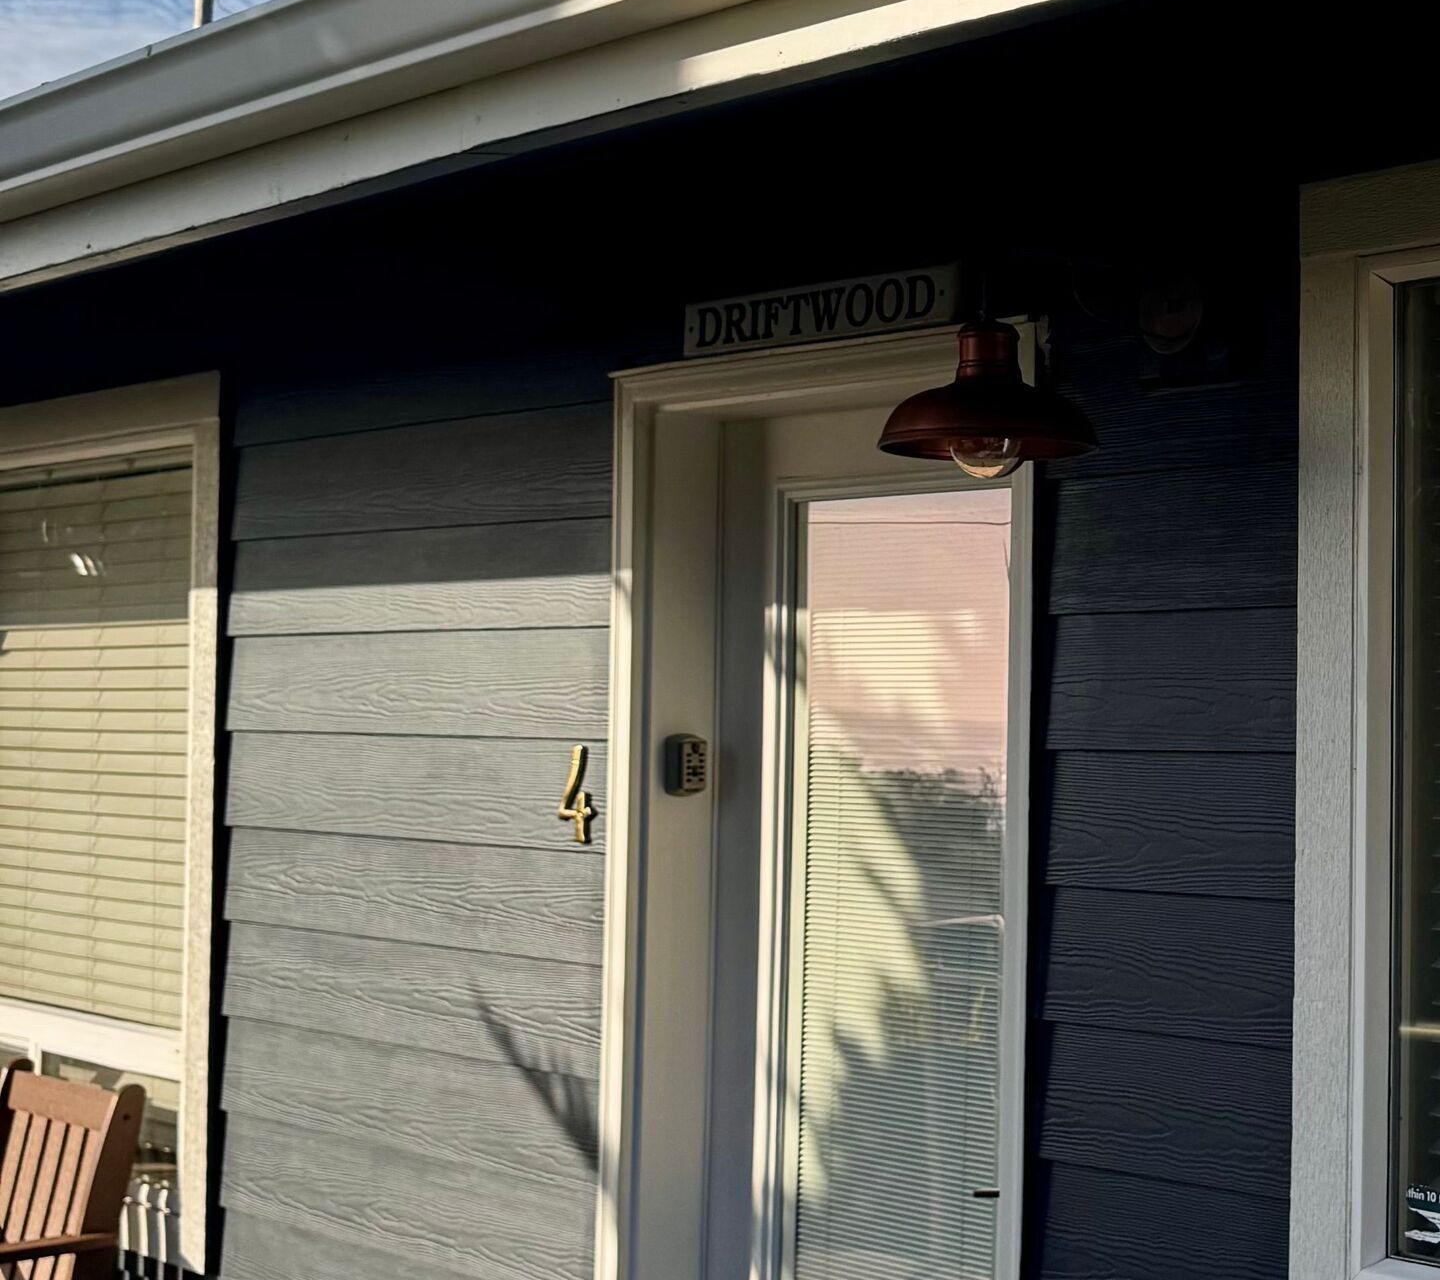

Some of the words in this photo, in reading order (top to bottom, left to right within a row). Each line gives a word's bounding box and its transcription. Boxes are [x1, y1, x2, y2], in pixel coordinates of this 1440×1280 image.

[695, 274, 936, 348] DRIFTWOOD
[558, 744, 592, 842] 4
[1426, 1191, 1437, 1203] 10
